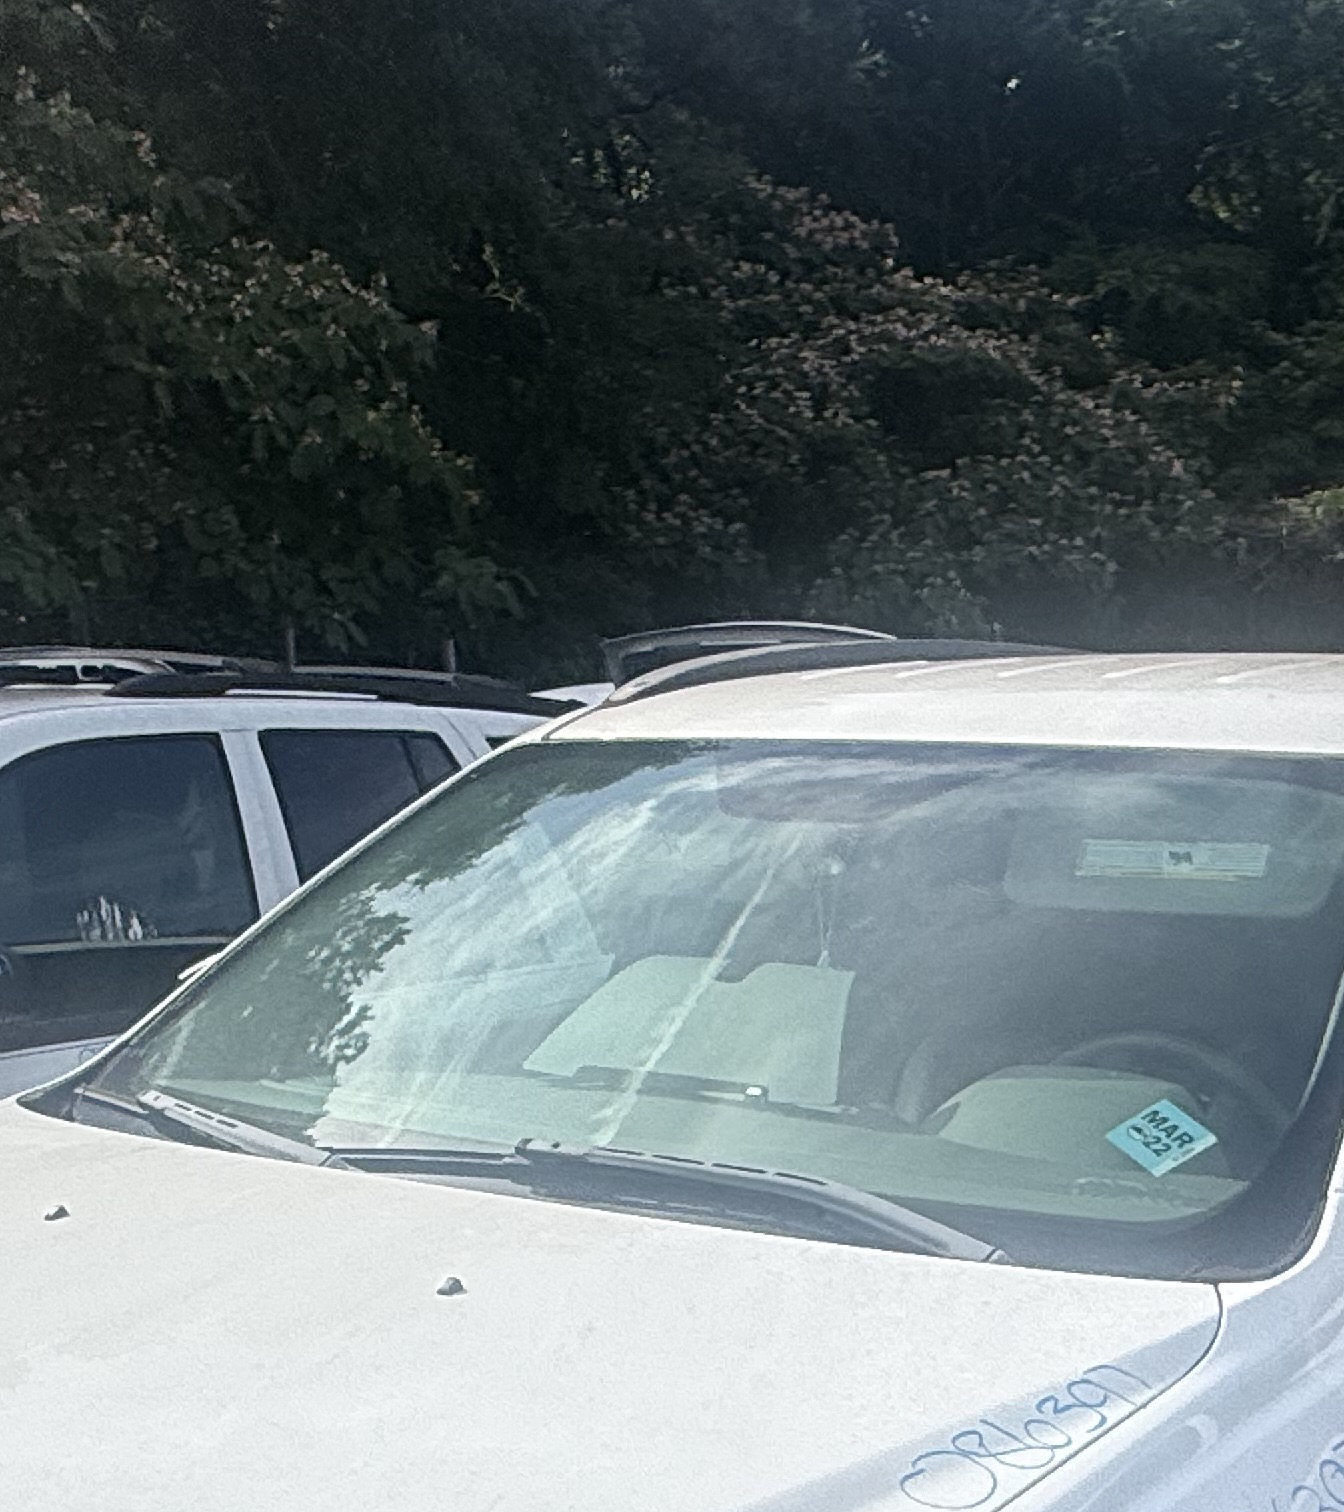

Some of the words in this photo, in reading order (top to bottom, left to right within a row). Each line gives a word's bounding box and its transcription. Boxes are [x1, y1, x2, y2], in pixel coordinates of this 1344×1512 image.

[1140, 1109, 1195, 1149] MAR
[1141, 1135, 1172, 1158] 22
[899, 1364, 1152, 1510] 086397
